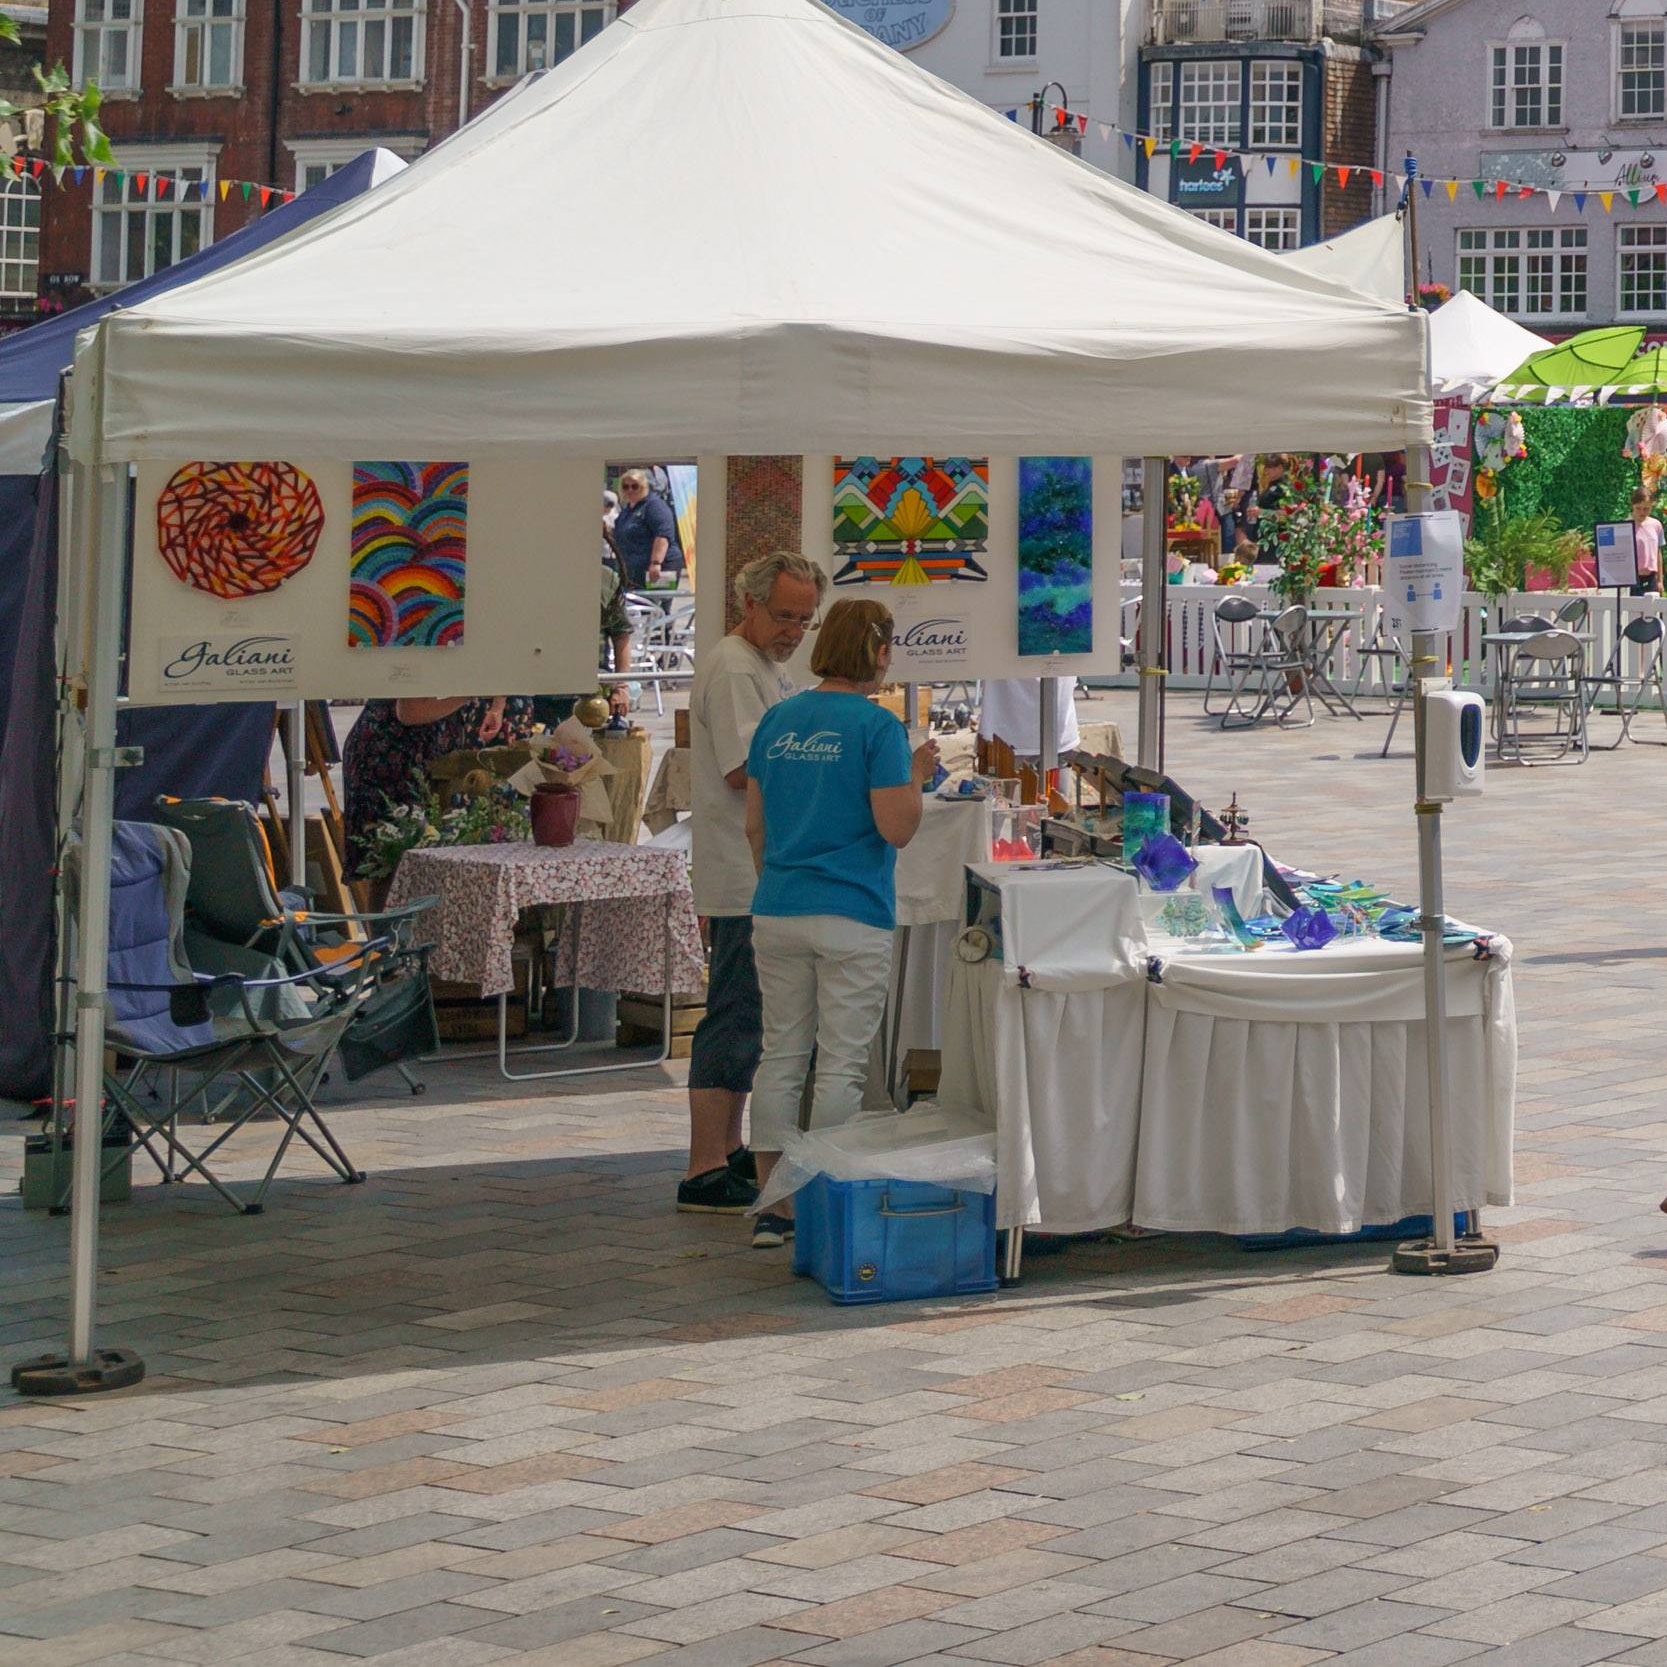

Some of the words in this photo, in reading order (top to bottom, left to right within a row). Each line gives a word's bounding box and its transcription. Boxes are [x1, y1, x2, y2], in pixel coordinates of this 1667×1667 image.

[864, 8, 887, 22] OF
[891, 619, 969, 647] aliani
[906, 648, 945, 656] GLASS
[946, 647, 967, 655] ART
[226, 668, 267, 676] GLASS
[270, 667, 293, 675] ART
[784, 752, 820, 761] GLASS
